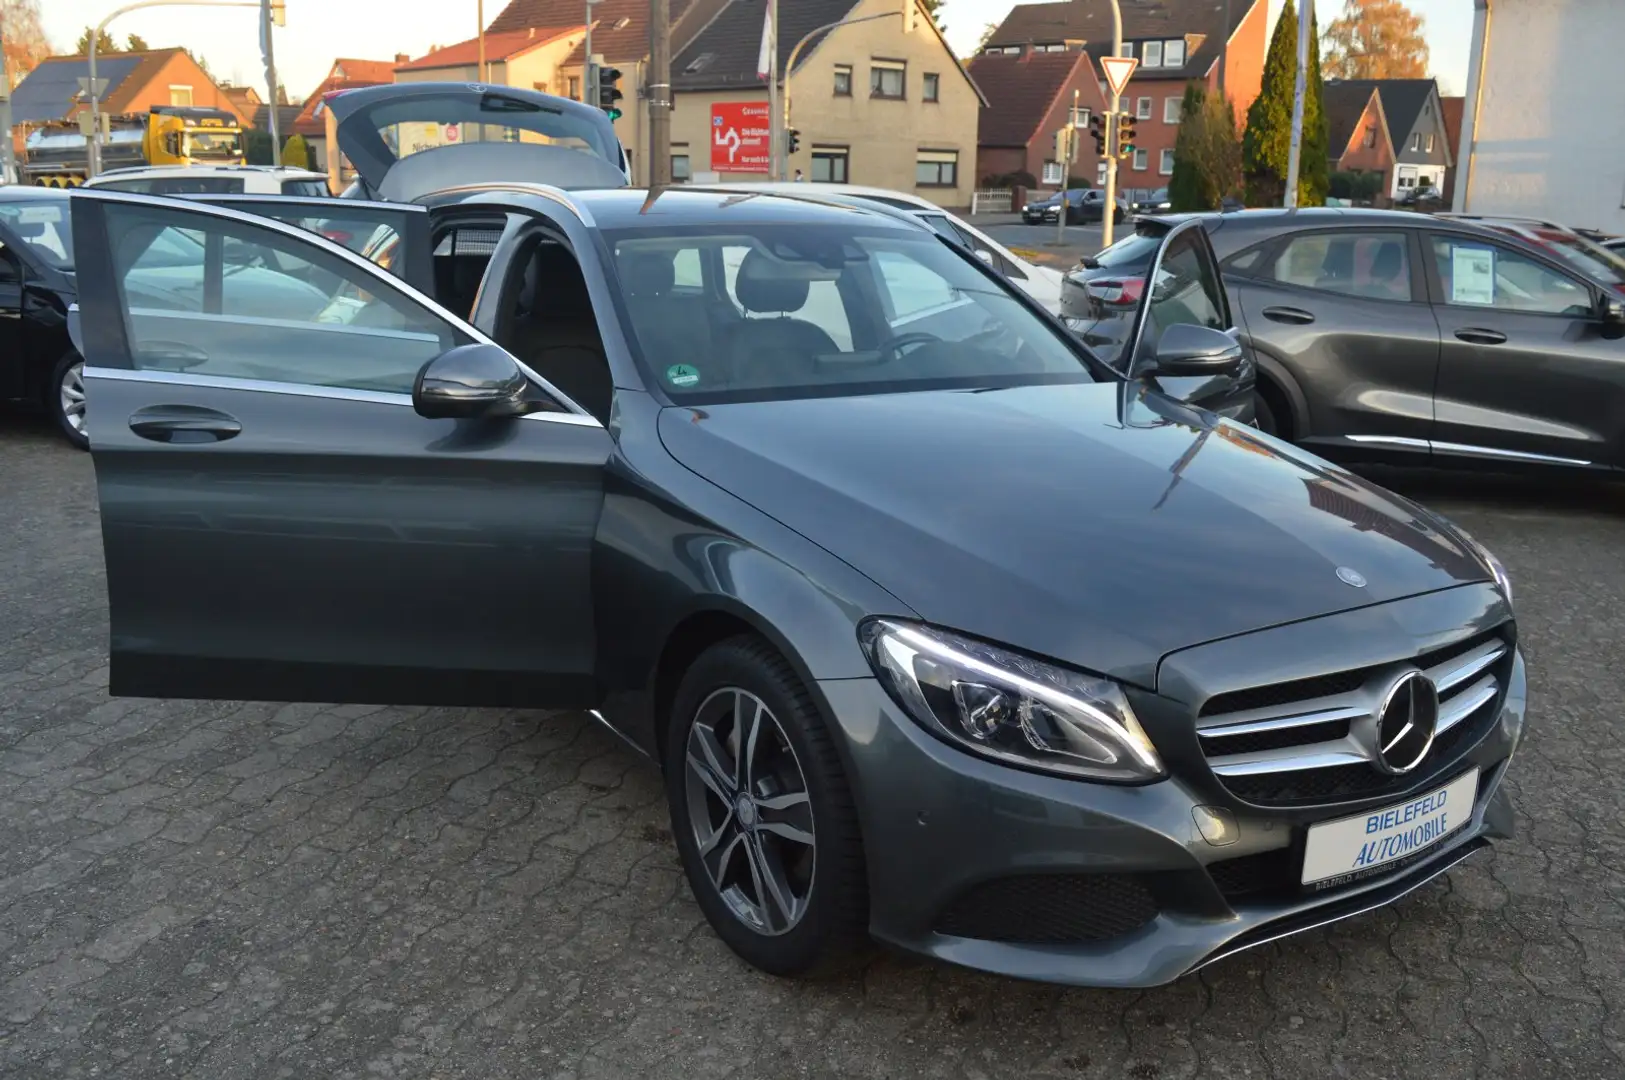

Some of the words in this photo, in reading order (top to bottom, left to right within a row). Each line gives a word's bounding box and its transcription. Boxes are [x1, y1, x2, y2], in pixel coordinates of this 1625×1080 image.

[677, 366, 687, 375] 4
[1366, 790, 1447, 834] BIELEFELD
[1352, 812, 1447, 867] AUTOMOBILE
